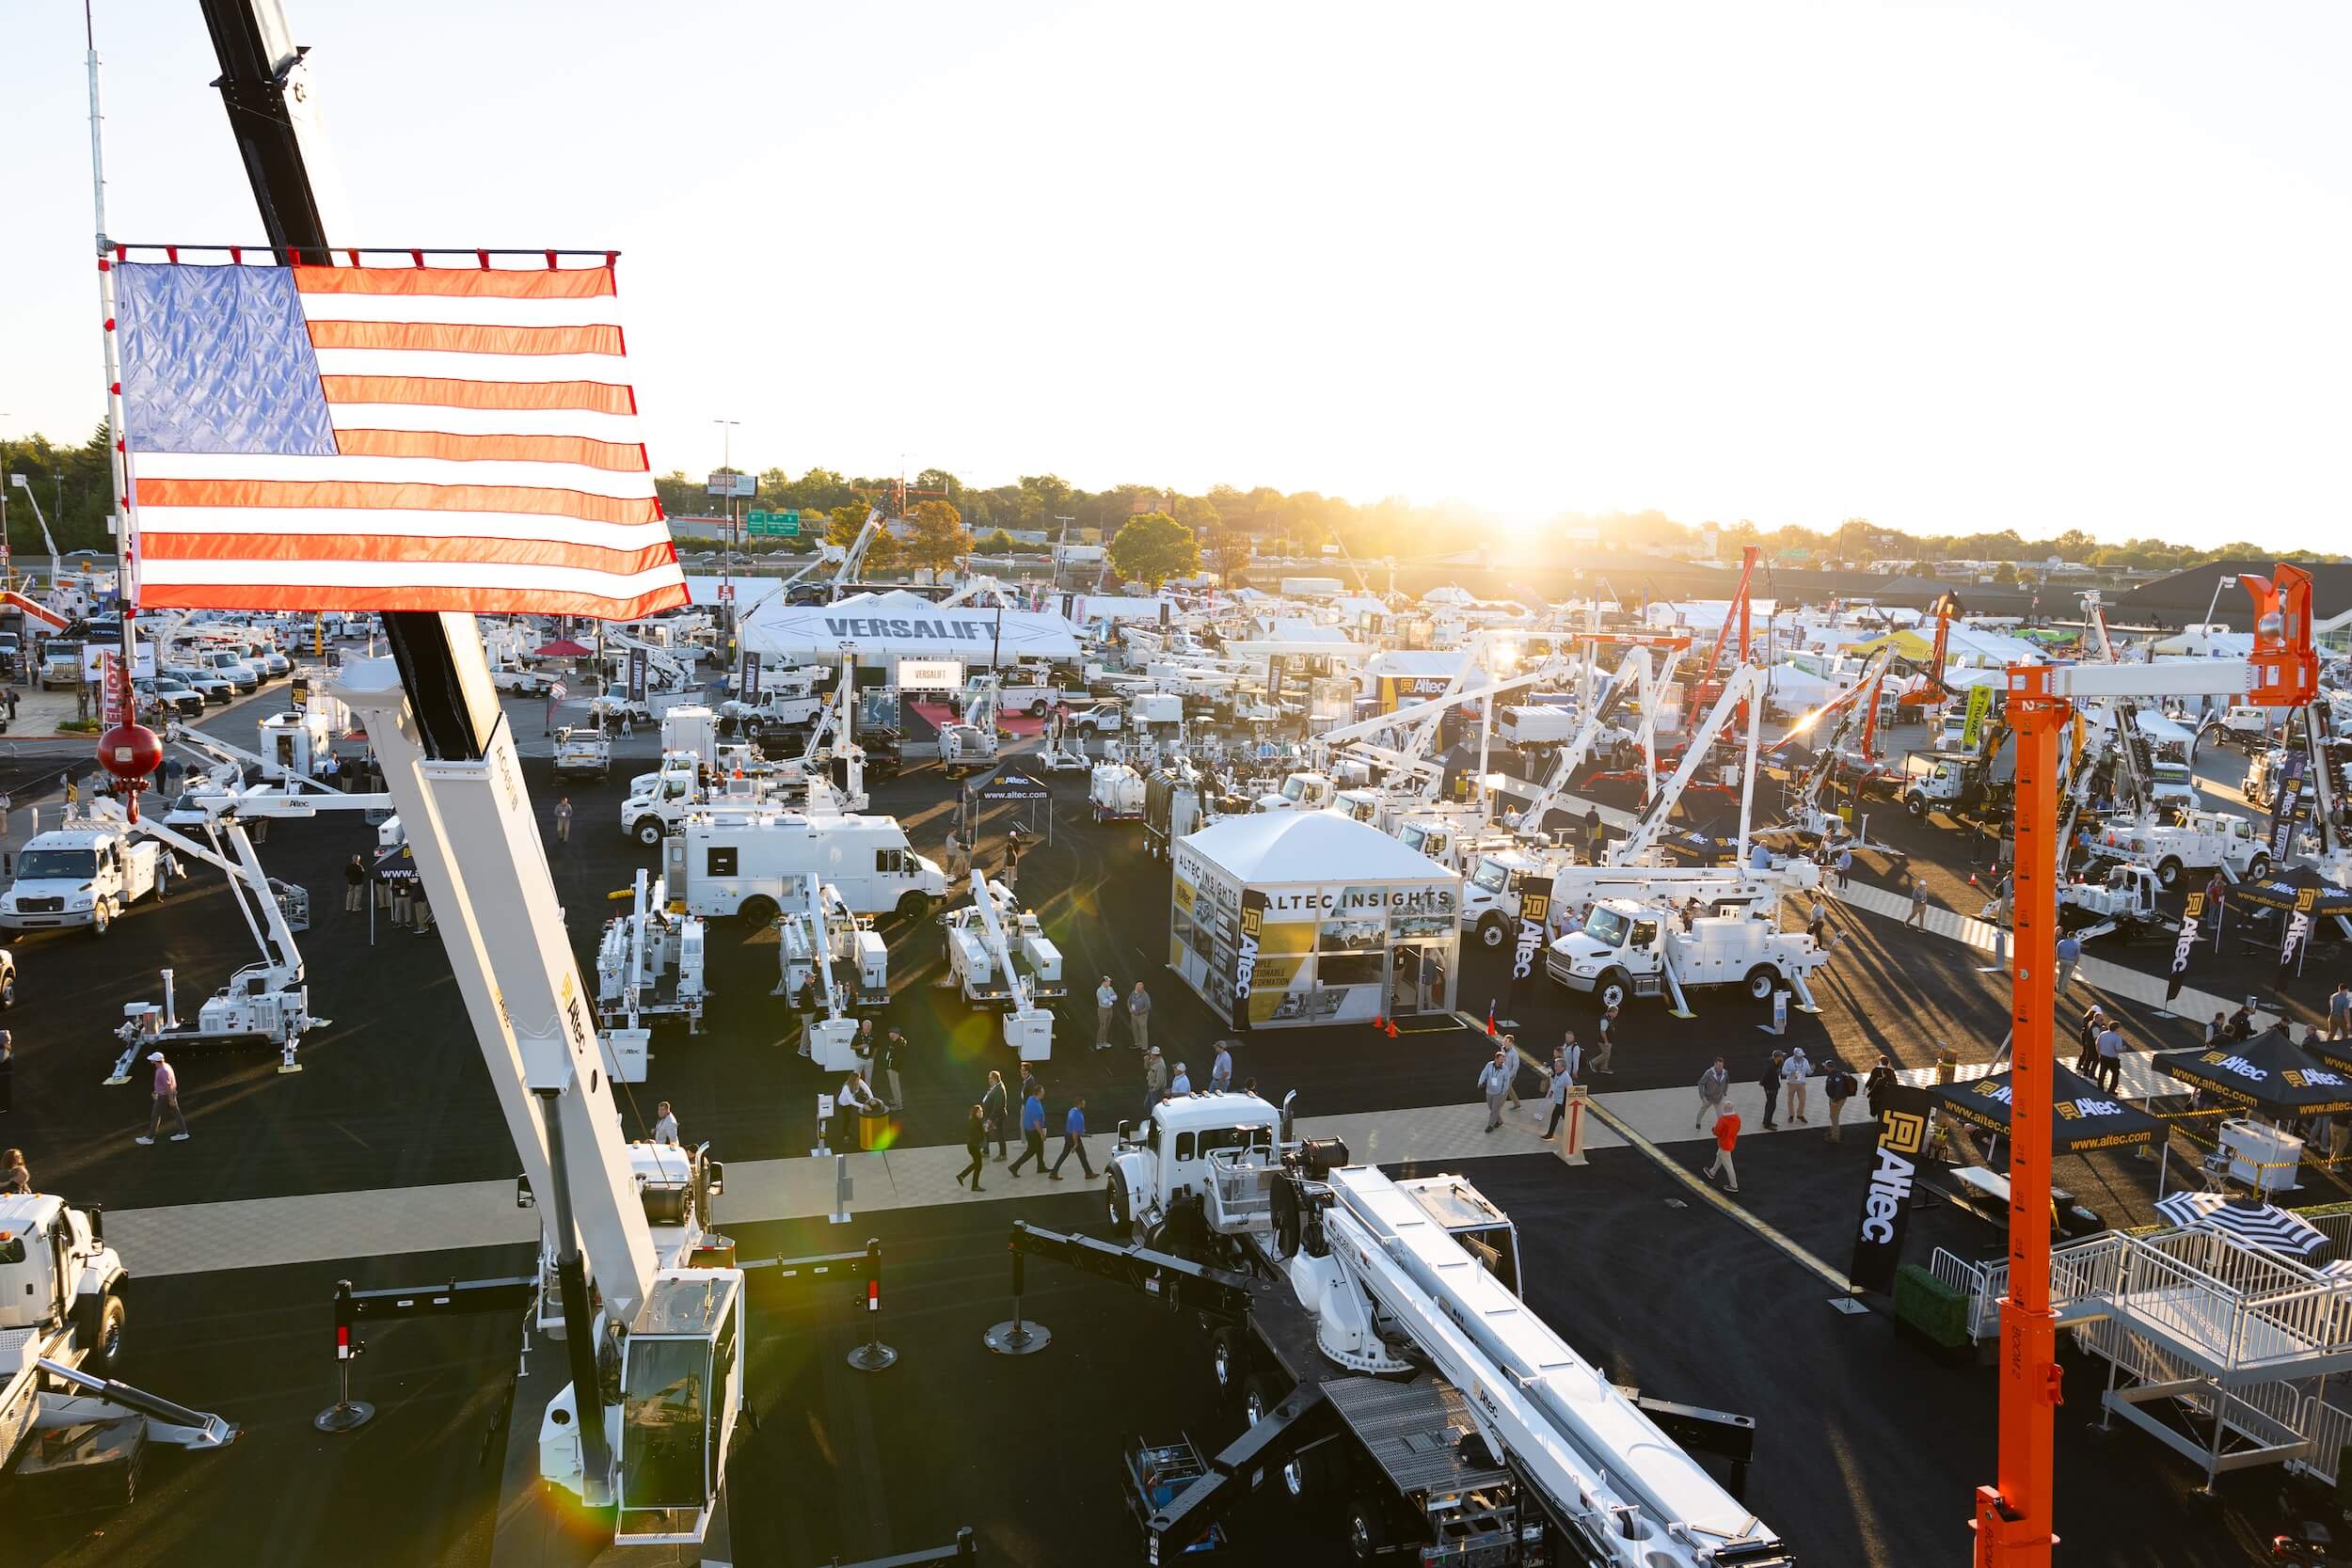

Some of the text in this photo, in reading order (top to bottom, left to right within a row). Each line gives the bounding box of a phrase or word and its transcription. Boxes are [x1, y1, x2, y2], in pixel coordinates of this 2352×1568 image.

[825, 618, 997, 640] VERSALIFT
[745, 663, 756, 693] VERSALIFT
[914, 669, 947, 679] VERSALIFT
[1414, 678, 1446, 693] Altec
[1969, 700, 1986, 737] TRUVAC
[1006, 776, 1028, 784] Altec
[2280, 790, 2296, 816] Altec
[2273, 824, 2290, 861] TEUPEN
[1179, 855, 1237, 907] ALTEC INSGHTS
[2267, 881, 2296, 895] Altec
[1264, 890, 1450, 911] ALTEC INSIGHTS
[1513, 918, 1544, 978] Altec
[2172, 915, 2199, 973] Altec
[2281, 910, 2309, 965] Altec
[1235, 932, 1259, 999] Altec
[566, 996, 585, 1054] Altec
[2218, 1055, 2267, 1081] Altec
[2300, 1069, 2343, 1085] Altec
[2171, 1067, 2258, 1106] www.altec.com
[1944, 1100, 2010, 1135] www.altec.c
[2076, 1098, 2121, 1117] Altec
[2071, 1131, 2152, 1151] www.altec.com
[1862, 1146, 1915, 1245] Altec
[2011, 1325, 2022, 1370] BOOM
[1479, 1389, 1498, 1418] Altec
